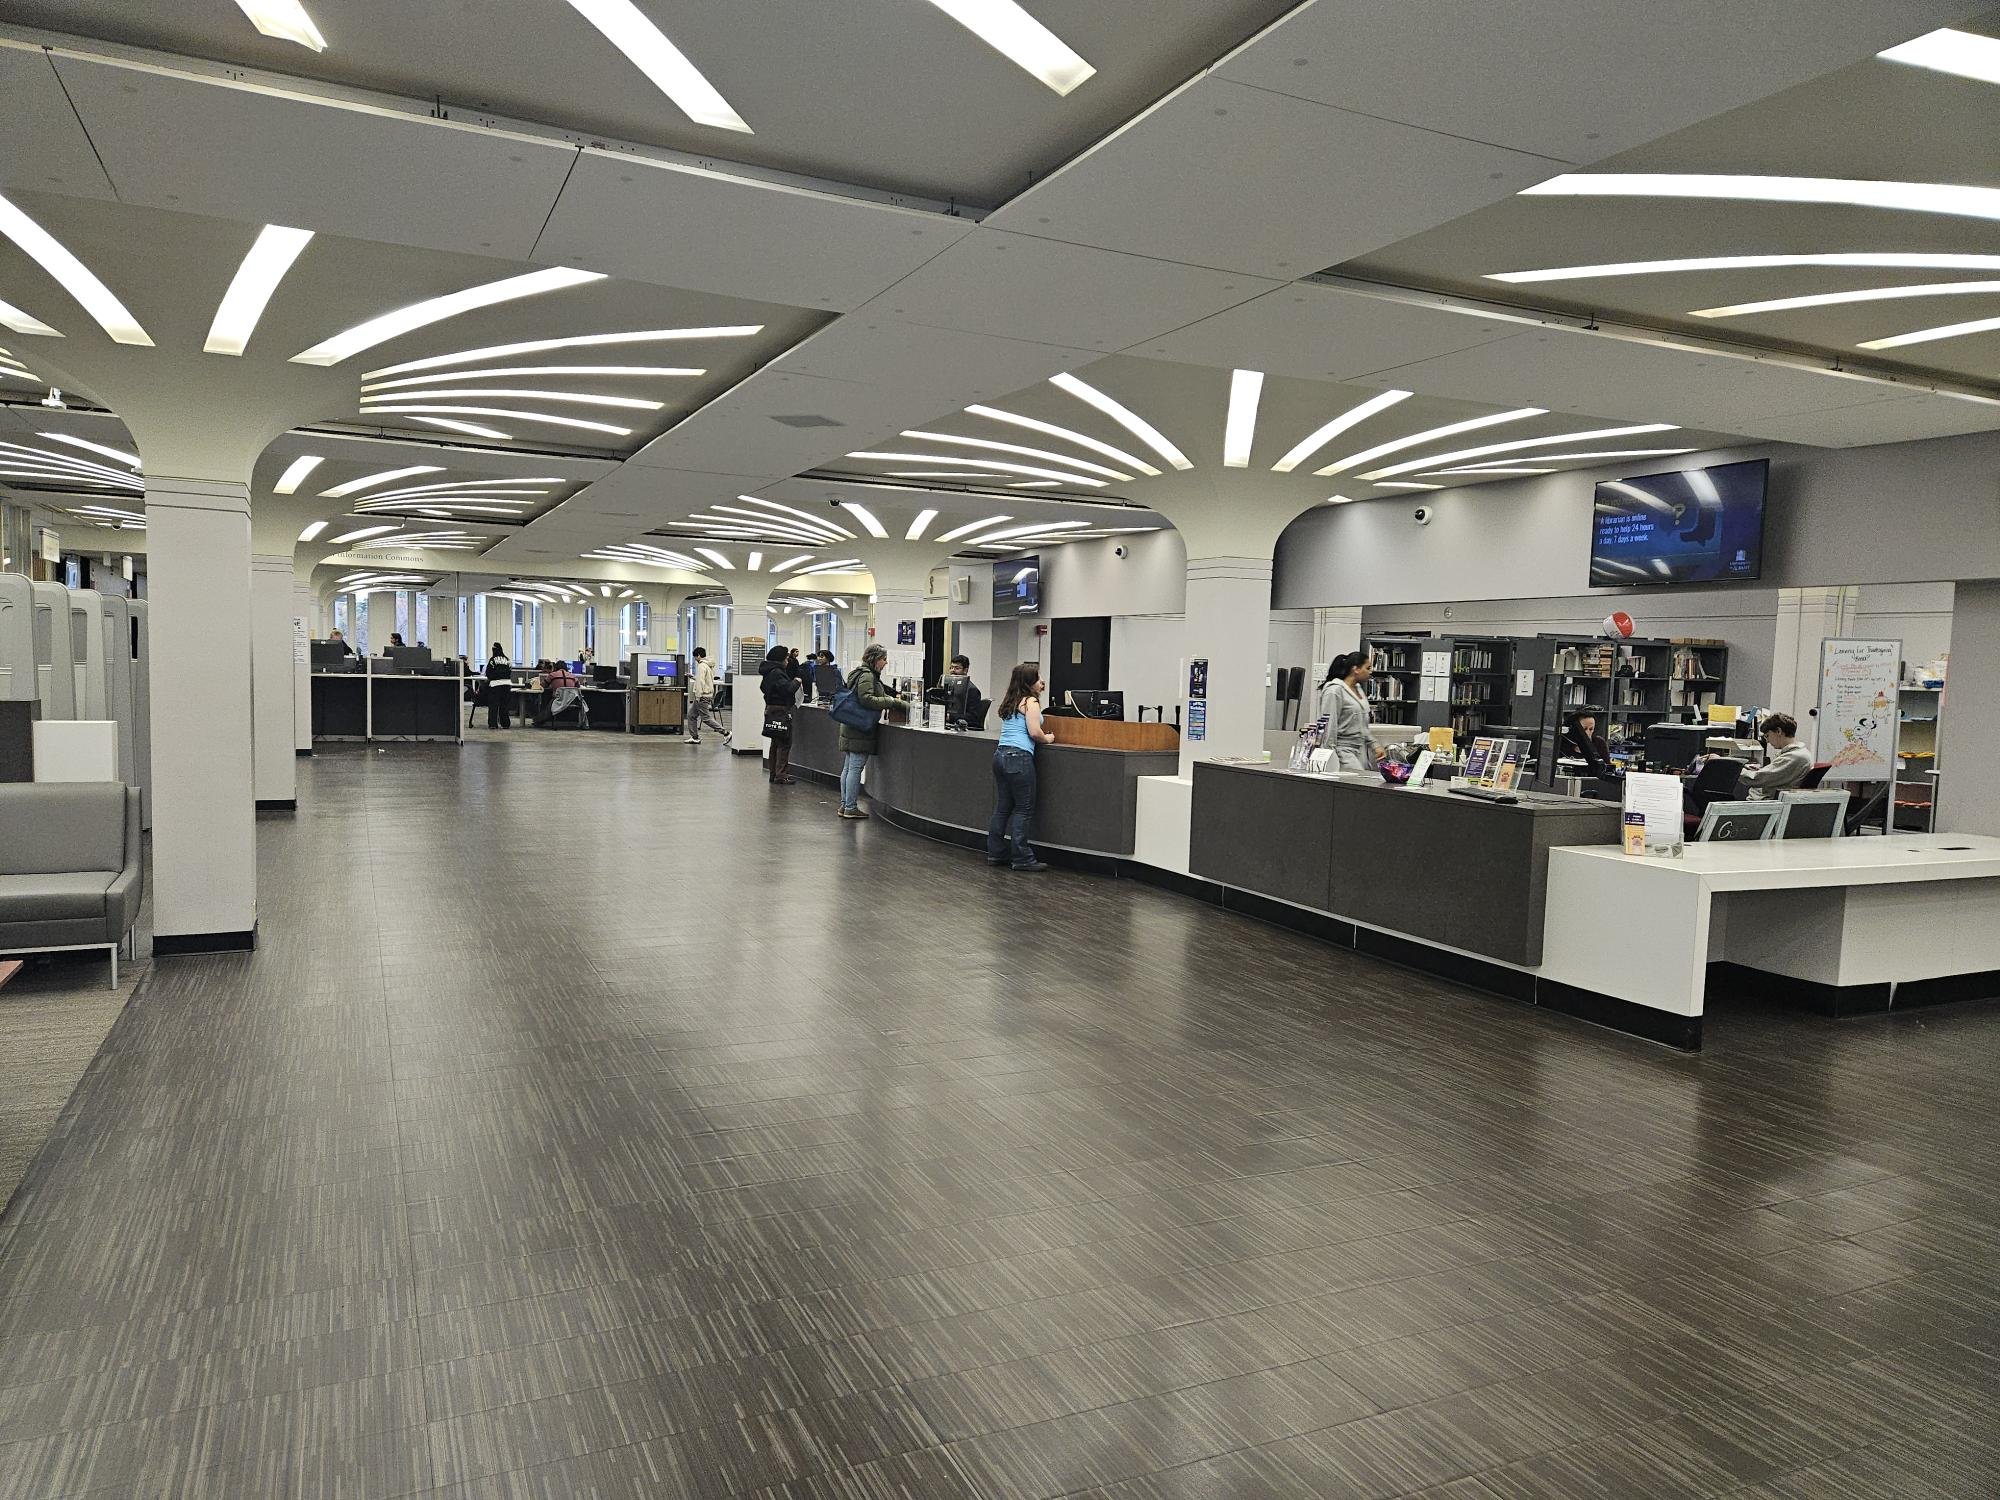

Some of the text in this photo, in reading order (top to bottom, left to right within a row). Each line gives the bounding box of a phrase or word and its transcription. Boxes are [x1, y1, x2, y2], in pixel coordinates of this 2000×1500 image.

[1631, 523, 1639, 532] 24
[1640, 523, 1655, 531] hours
[385, 553, 424, 563] Commons
